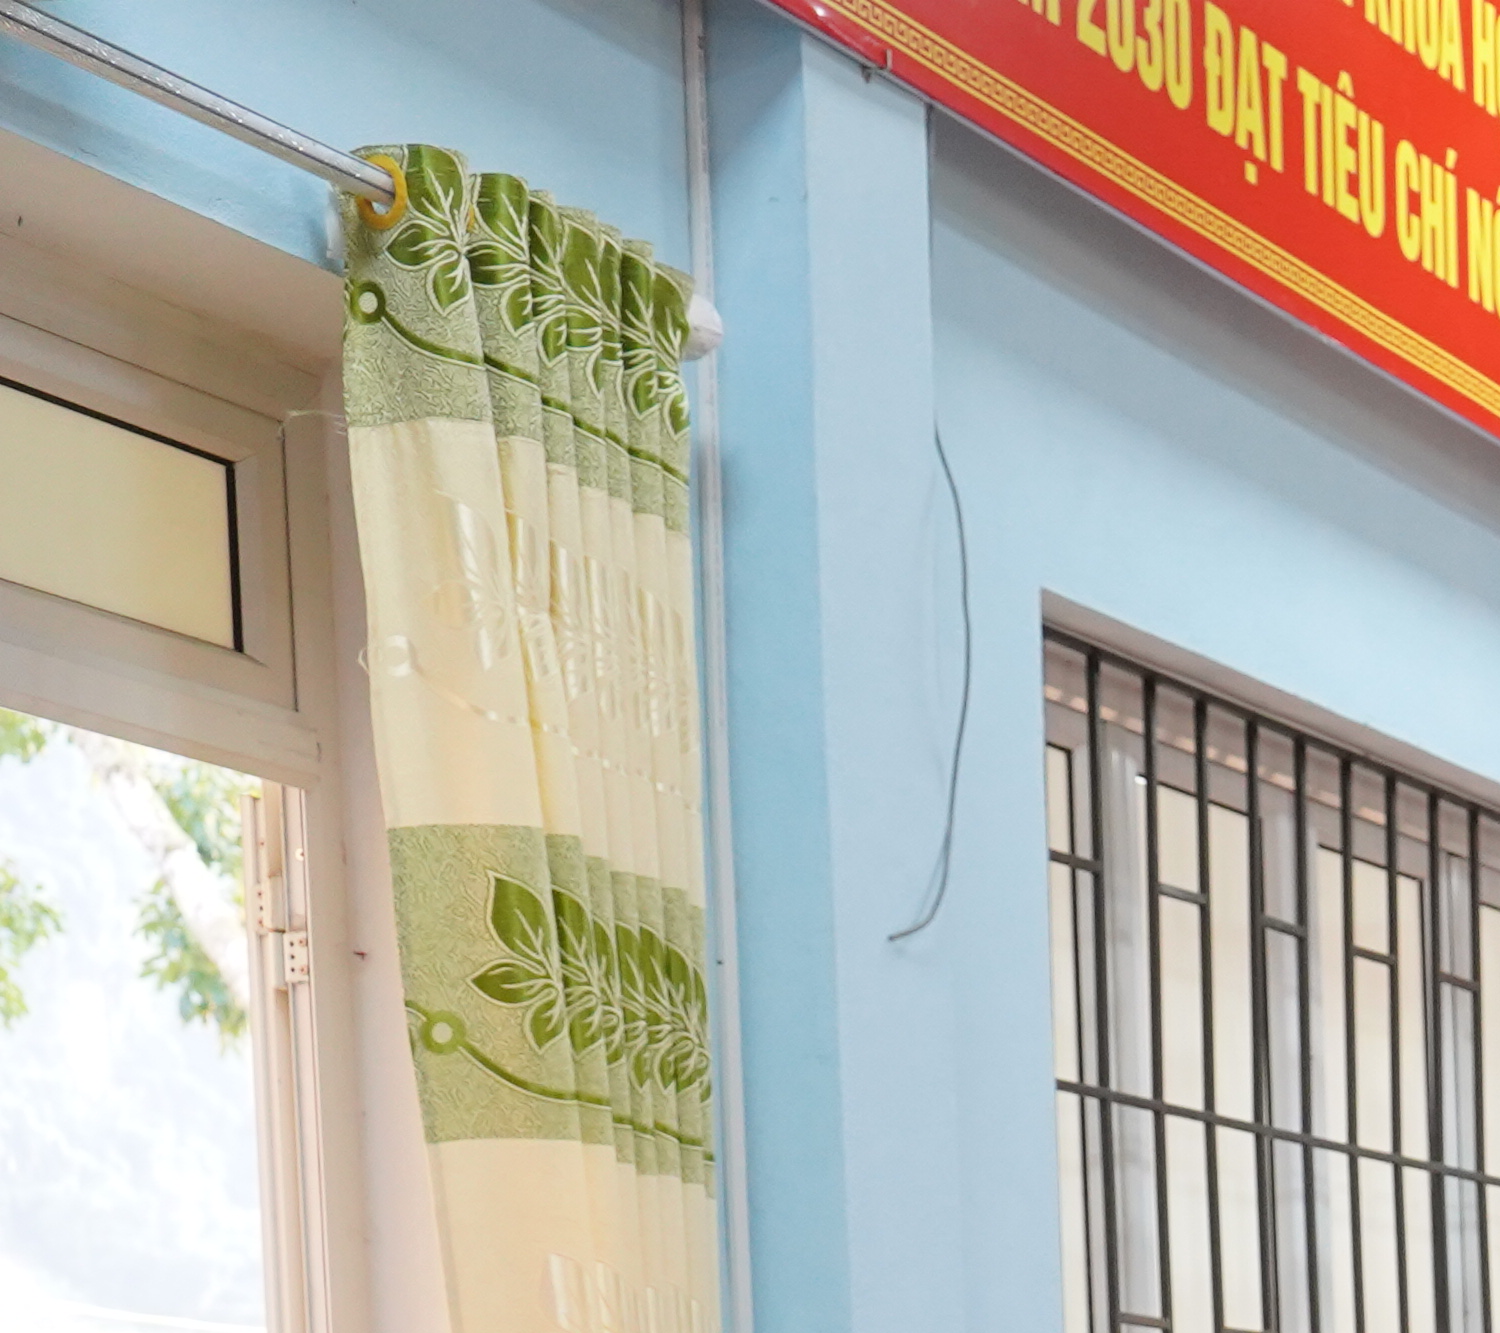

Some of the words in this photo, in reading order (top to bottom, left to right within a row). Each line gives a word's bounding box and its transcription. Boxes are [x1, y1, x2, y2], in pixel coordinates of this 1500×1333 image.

[1203, 1, 1289, 186] ĐẠT
[1297, 65, 1386, 239] TIÊU
[1395, 138, 1459, 289] CHÍ
